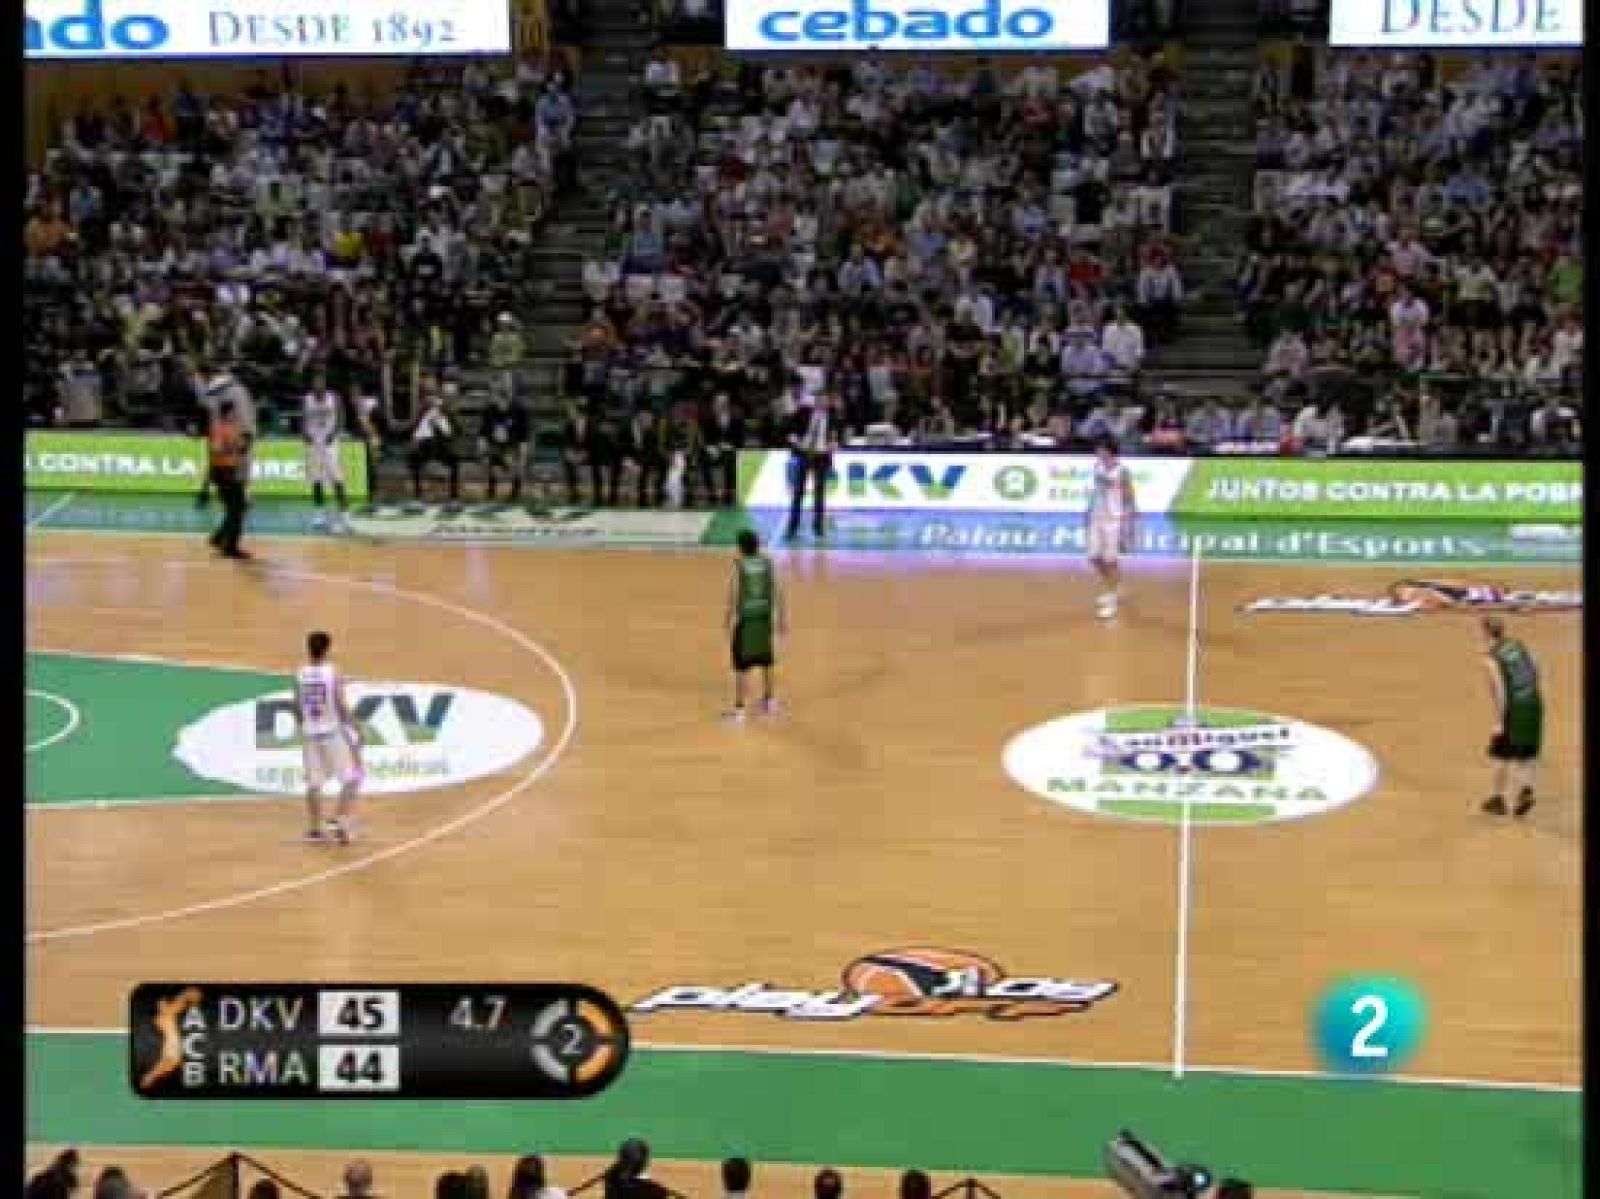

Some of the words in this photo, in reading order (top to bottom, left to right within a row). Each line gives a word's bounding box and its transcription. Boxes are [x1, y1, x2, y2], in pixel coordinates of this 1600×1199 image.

[209, 11, 350, 46] DESDE
[371, 17, 456, 47] 1892
[759, 0, 1053, 41] cebado
[1382, 0, 1561, 33] DESDE
[1209, 478, 1317, 501] JUNTOS
[1326, 481, 1448, 501] CONTRA
[1458, 482, 1497, 501] LA
[921, 523, 1037, 547] Palau
[1046, 777, 1327, 802] MANZANA
